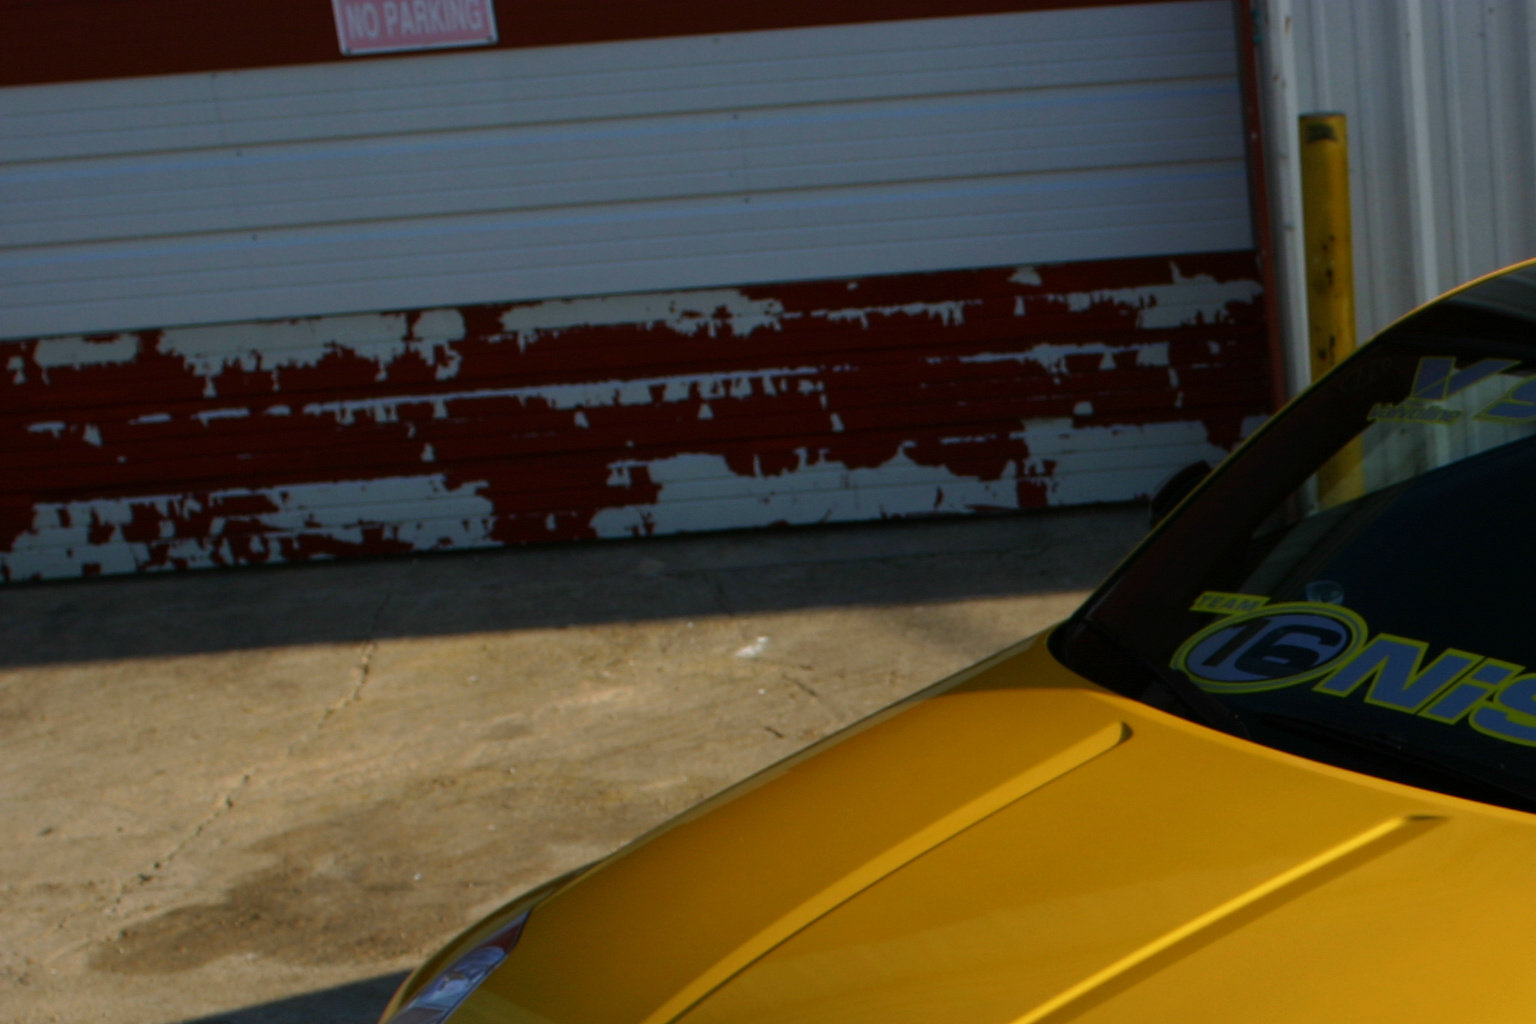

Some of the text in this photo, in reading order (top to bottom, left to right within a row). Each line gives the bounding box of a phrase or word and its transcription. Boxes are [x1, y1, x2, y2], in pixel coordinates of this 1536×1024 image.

[345, 0, 484, 39] NO PARKING
[1195, 591, 1266, 613] TEAM
[1203, 619, 1342, 679] 16
